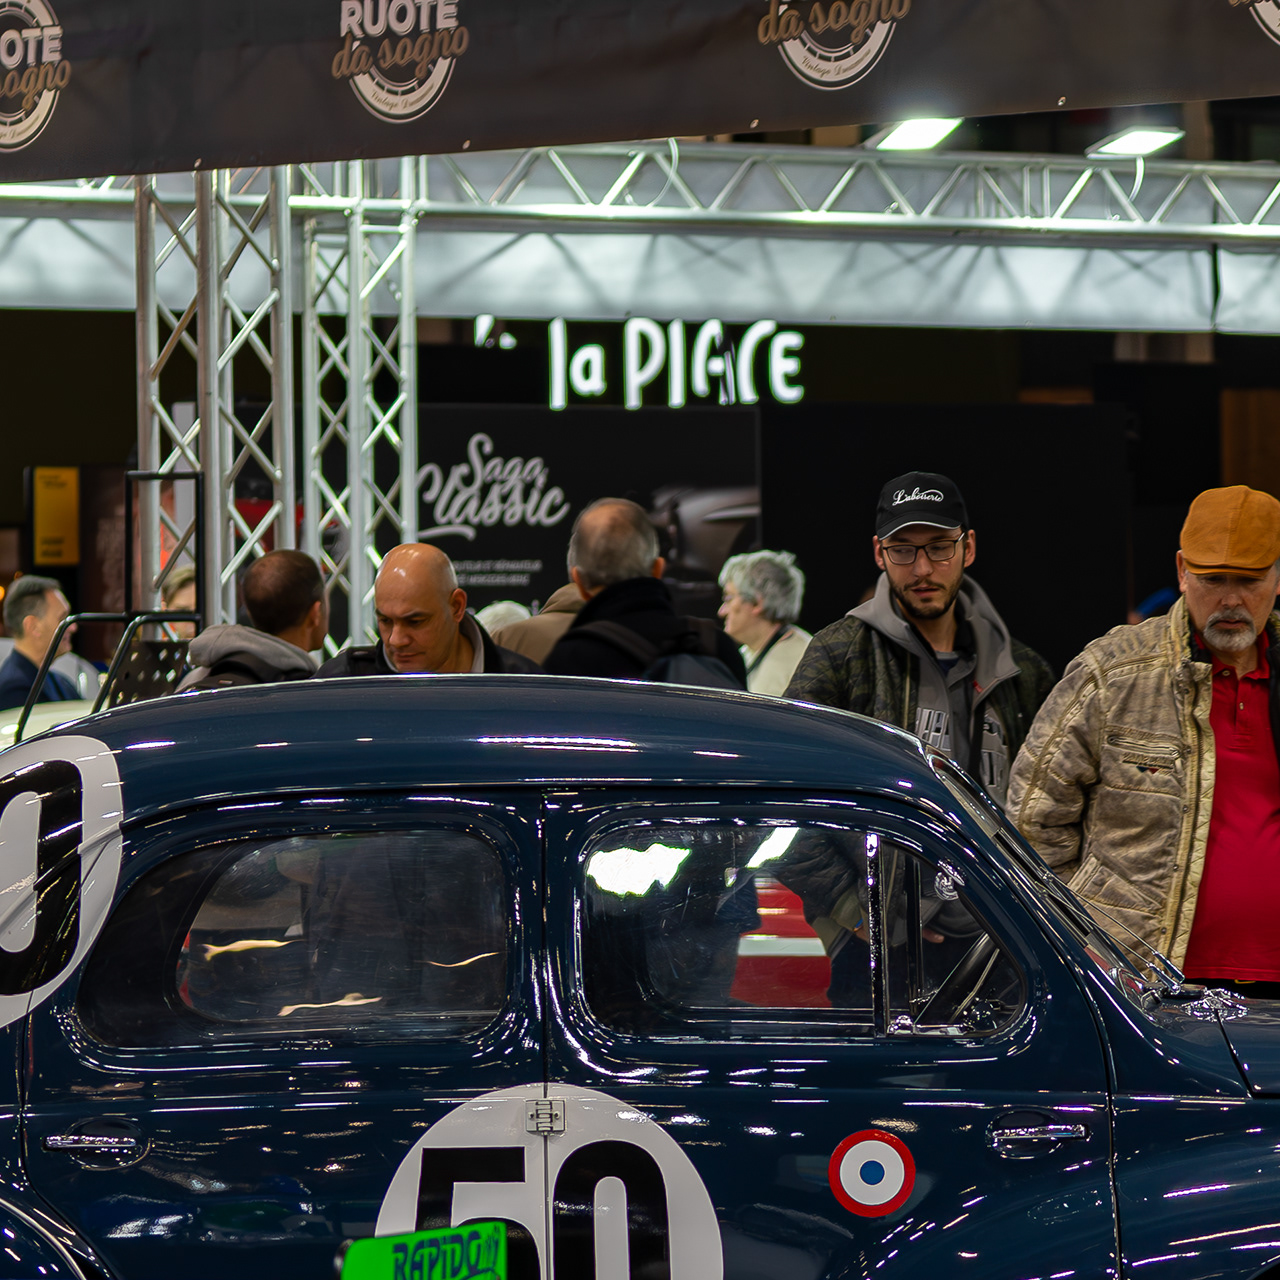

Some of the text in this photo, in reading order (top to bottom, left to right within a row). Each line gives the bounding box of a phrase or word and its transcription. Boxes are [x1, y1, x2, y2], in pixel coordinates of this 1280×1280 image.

[340, 0, 460, 38] RUOTE
[758, 0, 911, 45] da sogno
[331, 26, 470, 80] da sogno
[548, 316, 607, 411] la
[457, 432, 549, 495] Saga
